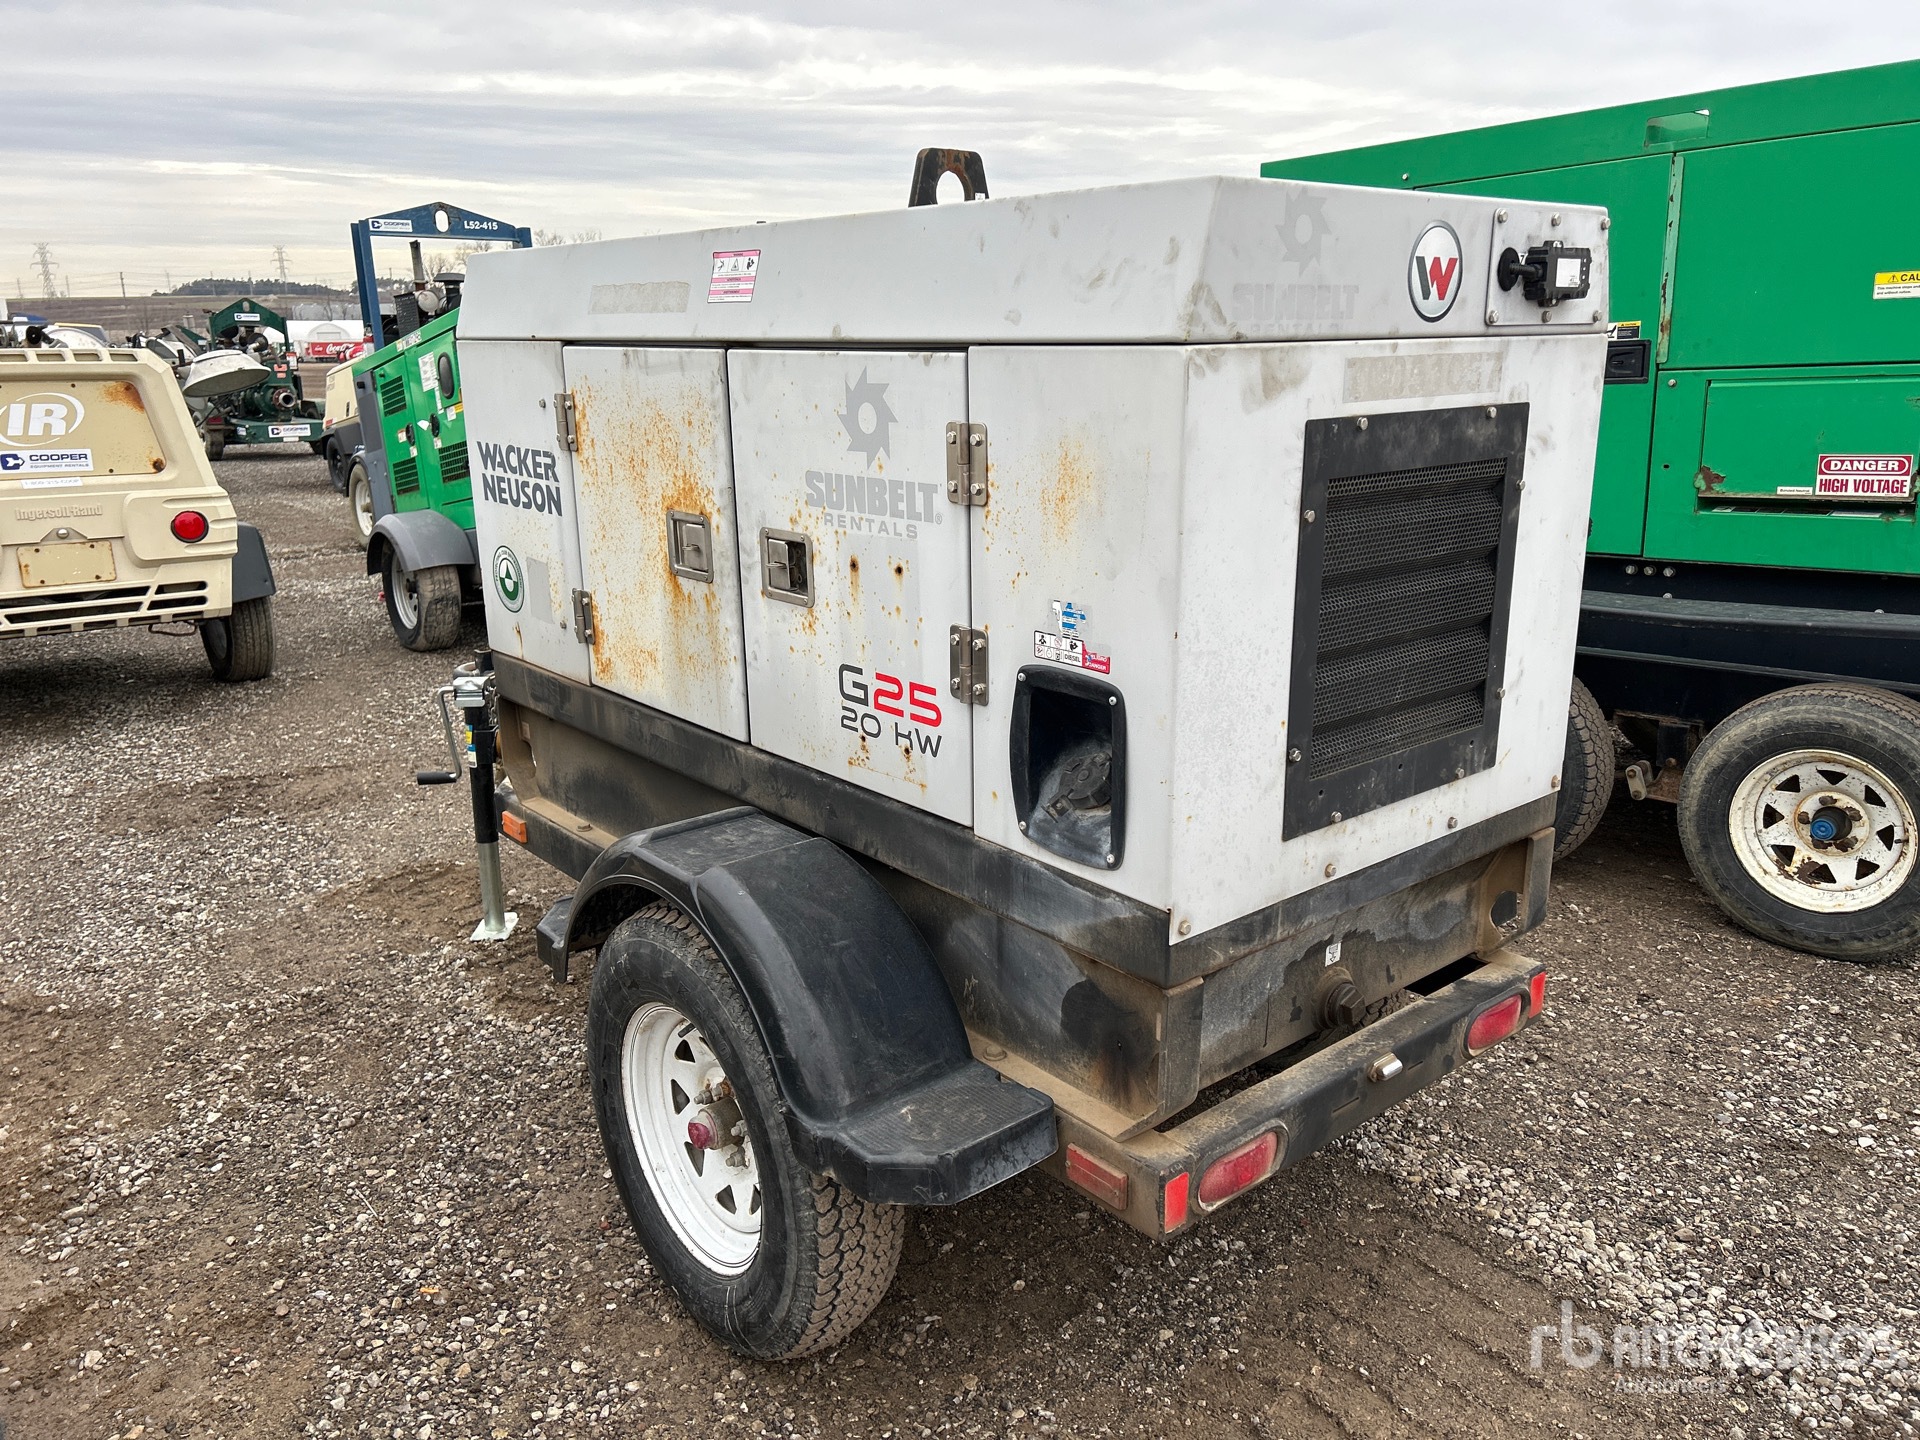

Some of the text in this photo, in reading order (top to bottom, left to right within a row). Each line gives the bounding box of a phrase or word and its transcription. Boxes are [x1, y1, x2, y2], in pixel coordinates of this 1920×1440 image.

[463, 220, 498, 230] L52-415
[1415, 255, 1458, 301] W
[7, 403, 68, 436] IR
[29, 453, 88, 462] COOPER
[477, 440, 560, 483] WACKER
[1830, 460, 1899, 471] DANGER
[482, 472, 563, 517] NEUSON
[805, 470, 938, 524] SUNBELT
[1818, 478, 1908, 494] HIGH VOLTAGE
[824, 512, 917, 540] RENTALS
[1064, 653, 1080, 663] DIESEL
[838, 663, 943, 728] G25
[841, 705, 882, 739] 20
